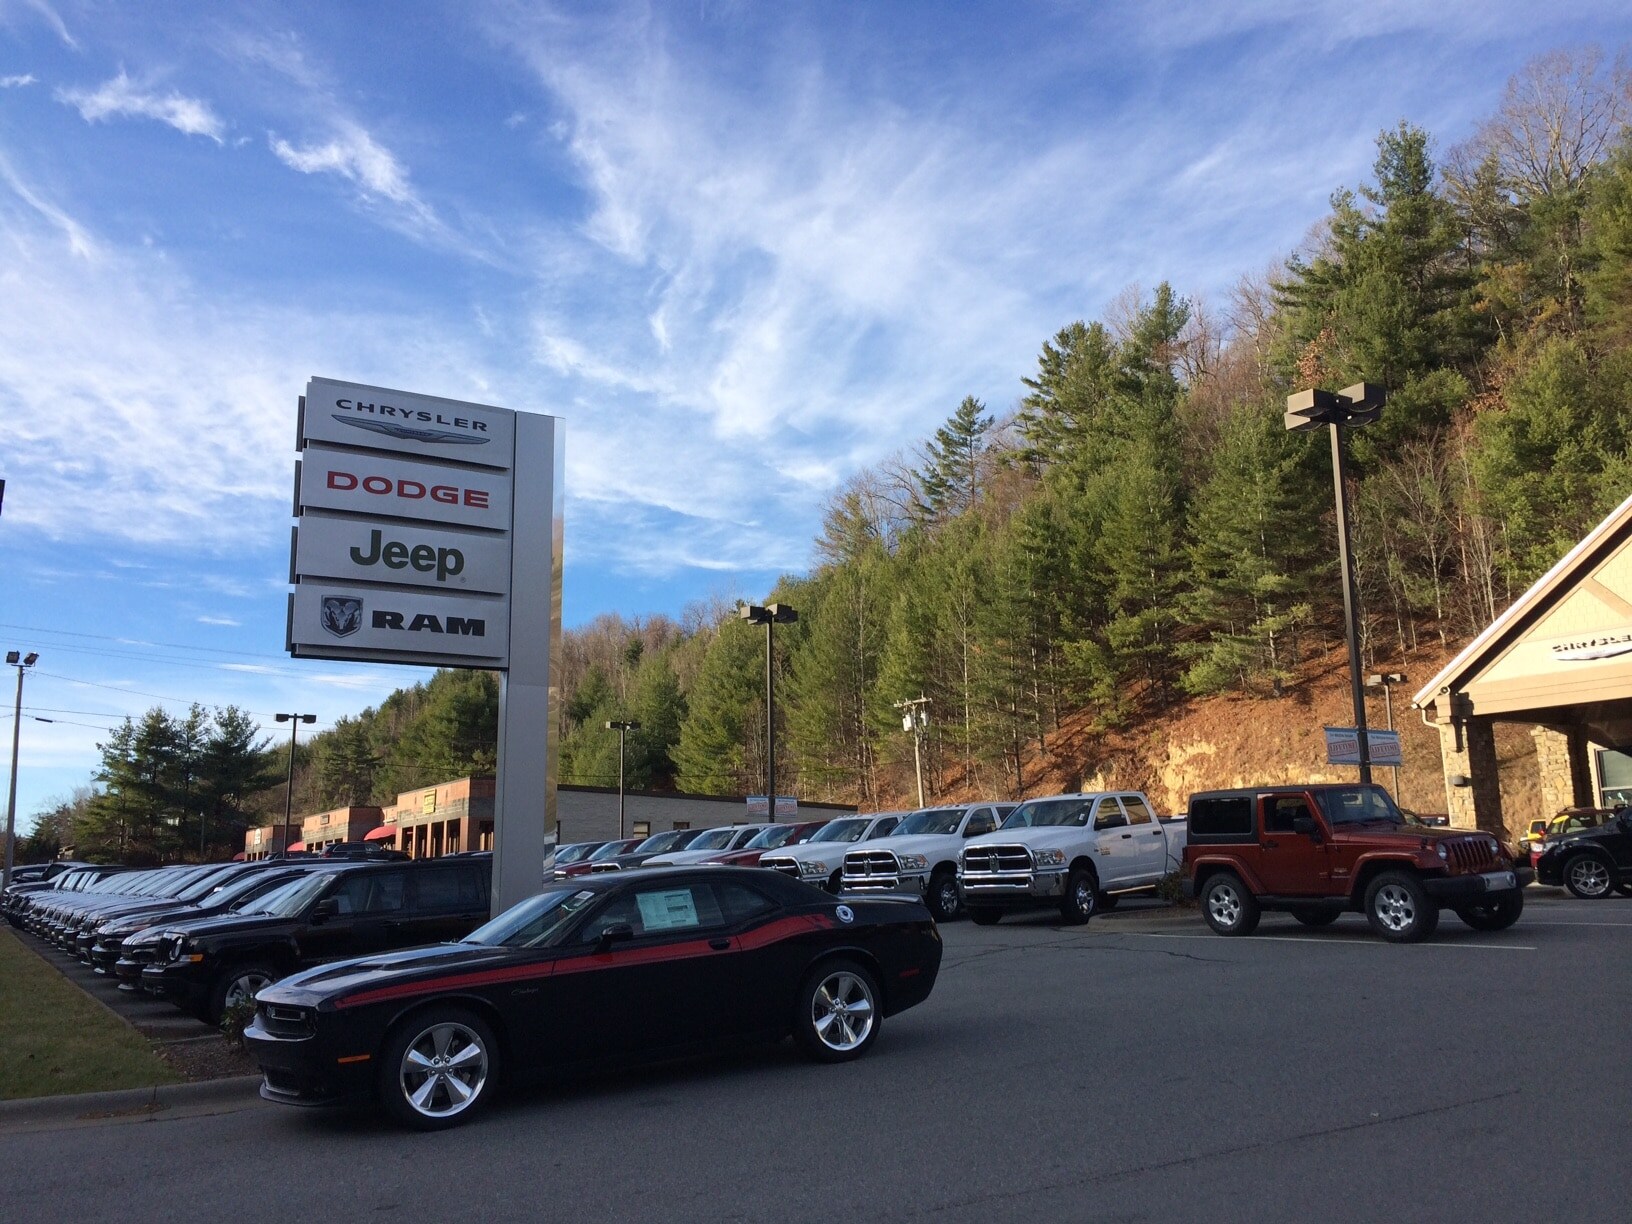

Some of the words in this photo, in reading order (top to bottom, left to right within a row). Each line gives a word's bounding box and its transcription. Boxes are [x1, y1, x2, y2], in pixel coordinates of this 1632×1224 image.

[336, 399, 487, 431] CHRYSLER
[327, 471, 489, 509] DODGE
[350, 529, 464, 581] Jeep
[372, 610, 485, 637] RAM
